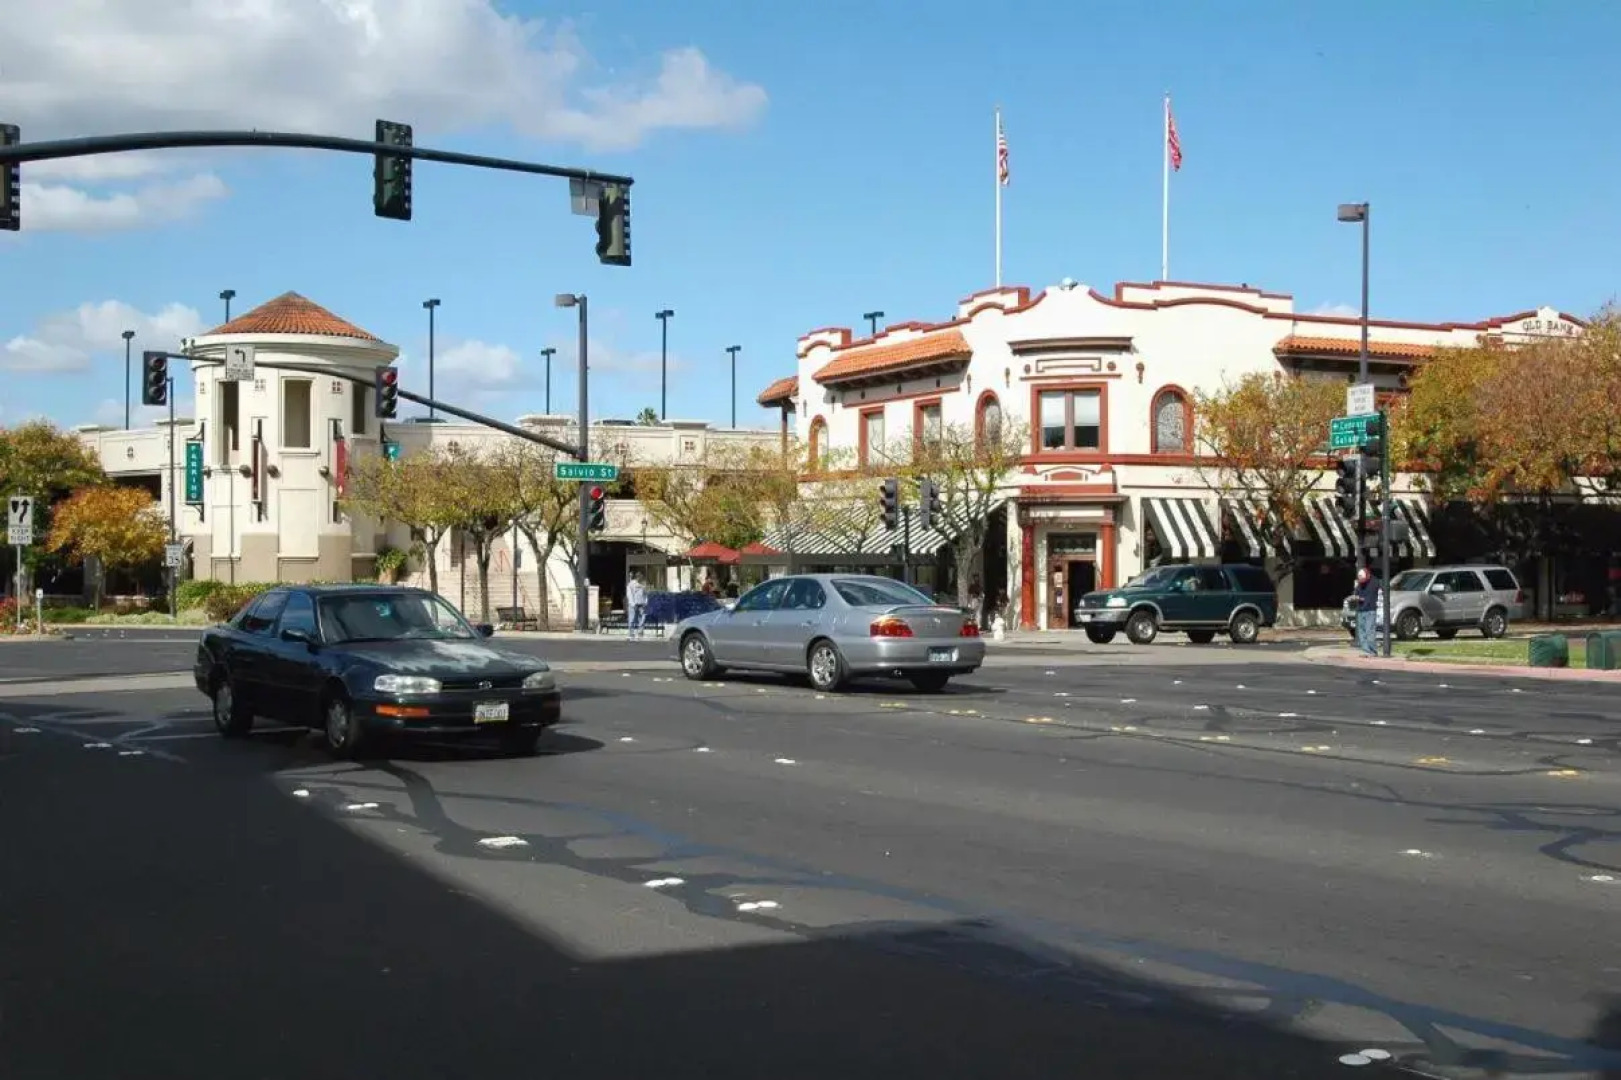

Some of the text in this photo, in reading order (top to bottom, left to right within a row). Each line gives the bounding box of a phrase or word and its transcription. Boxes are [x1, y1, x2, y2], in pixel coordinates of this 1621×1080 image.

[1522, 320, 1574, 335] OLD BANK
[560, 467, 612, 477] Salvio St
